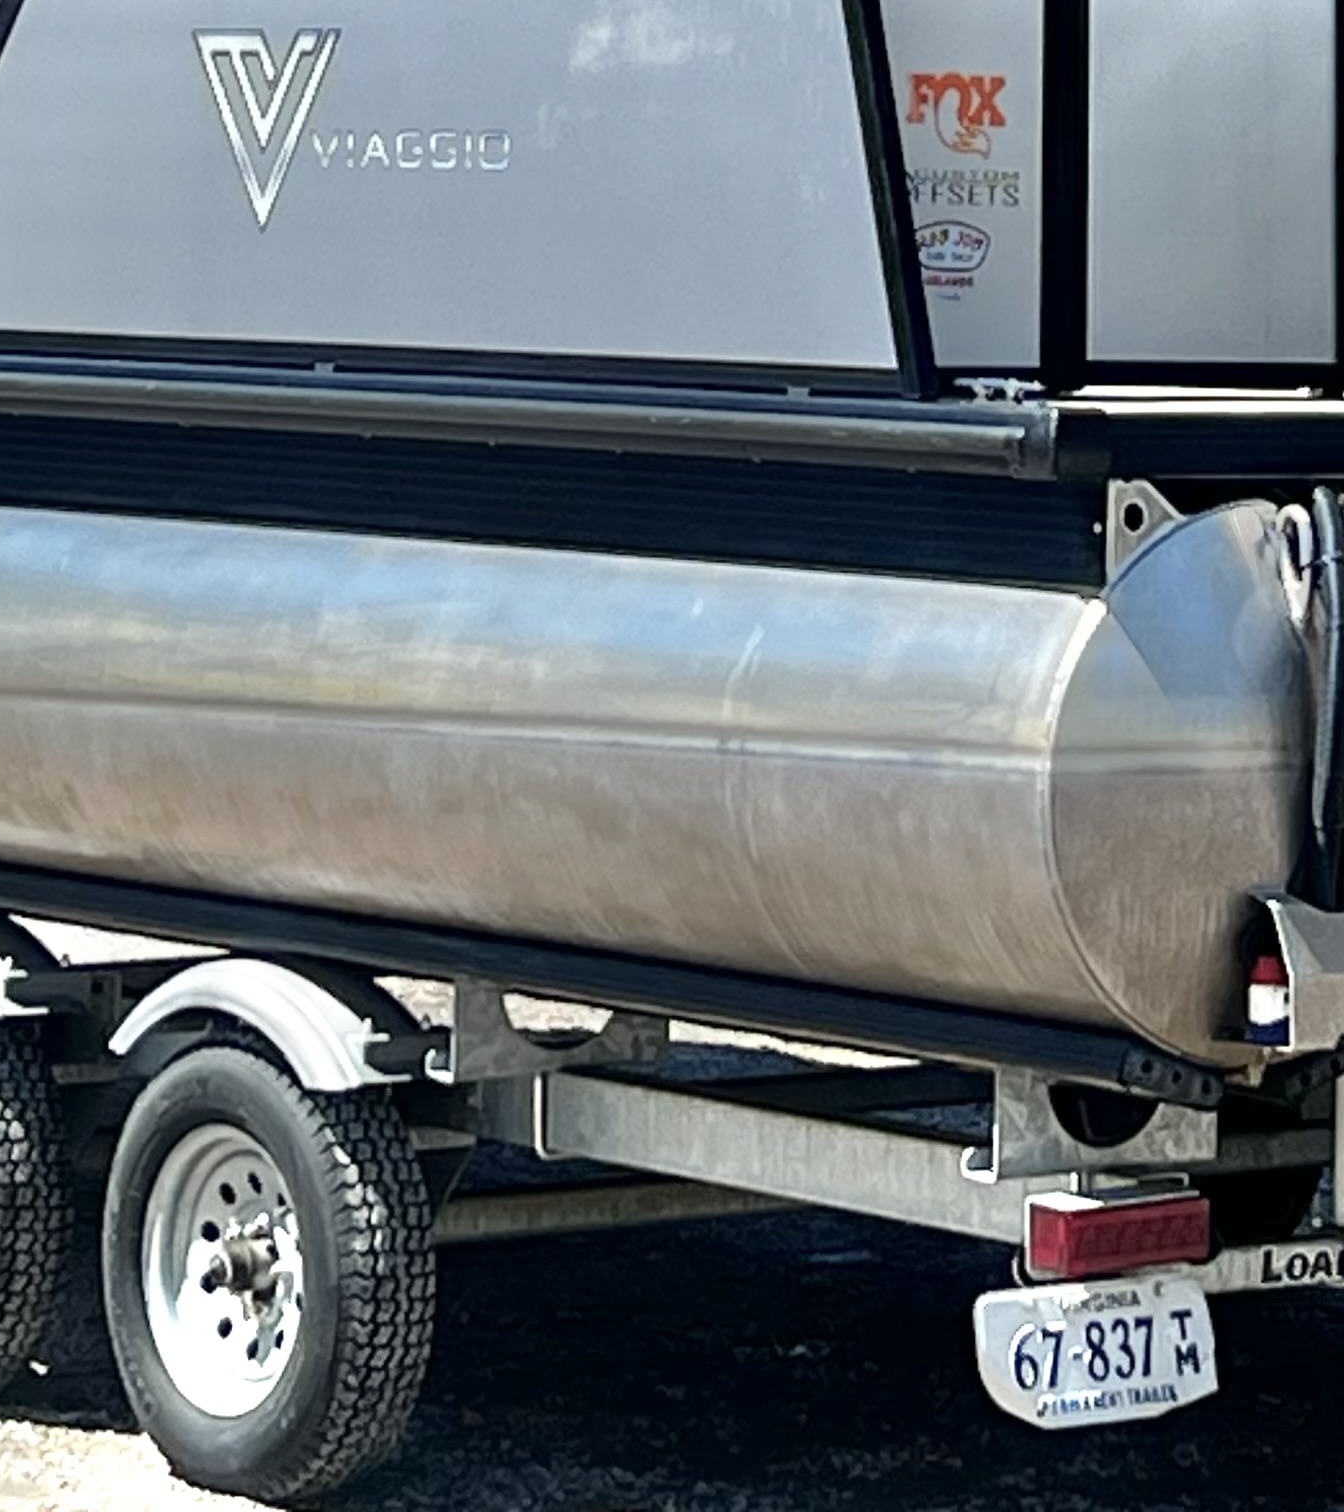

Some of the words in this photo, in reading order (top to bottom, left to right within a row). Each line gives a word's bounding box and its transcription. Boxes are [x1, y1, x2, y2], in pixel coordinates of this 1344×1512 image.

[907, 72, 1007, 134] FOX
[311, 131, 511, 170] VIAGGIO
[911, 184, 1020, 207] FFSETS
